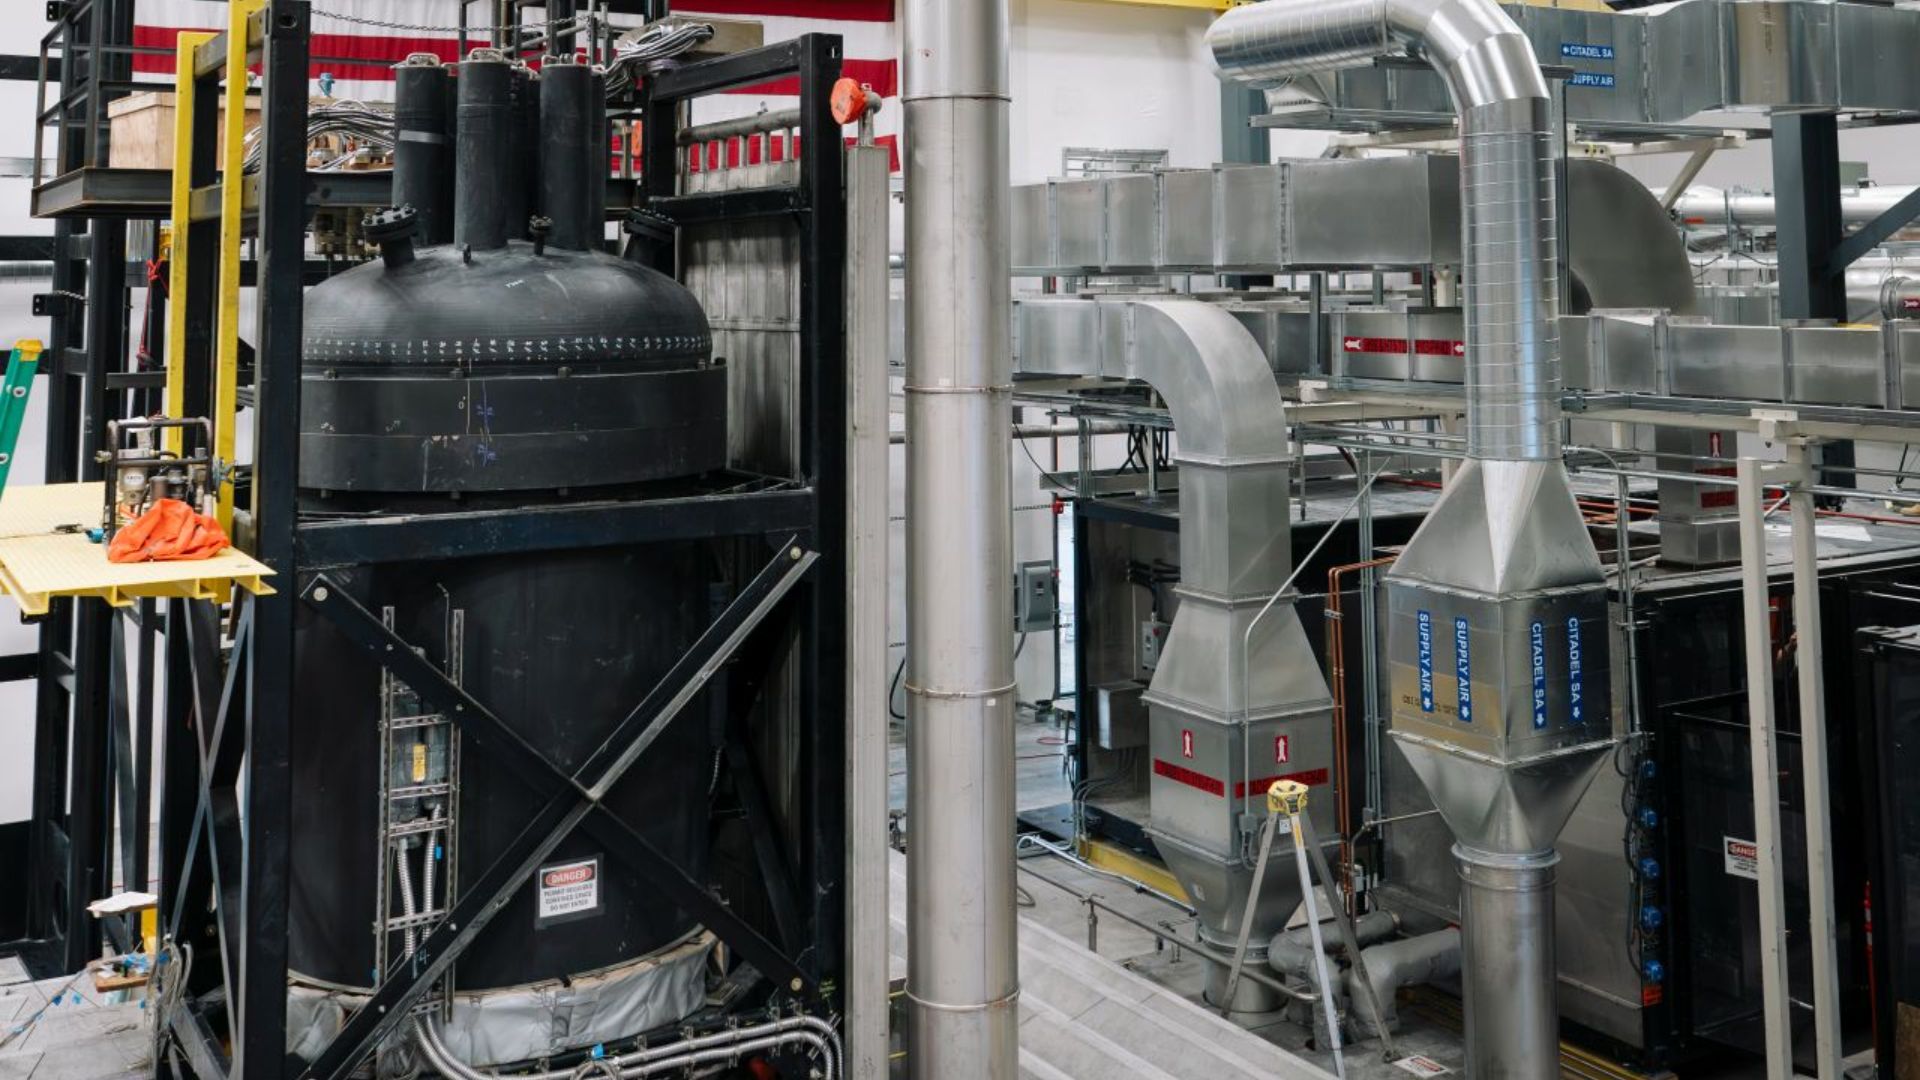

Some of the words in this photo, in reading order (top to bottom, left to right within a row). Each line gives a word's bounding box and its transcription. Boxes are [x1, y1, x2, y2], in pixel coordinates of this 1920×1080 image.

[1570, 45, 1601, 58] CITADEL
[1602, 47, 1613, 58] SA
[1601, 75, 1614, 87] AIR
[1419, 613, 1431, 668] SUPPLY
[1456, 620, 1468, 676] SUPPLY
[1568, 617, 1580, 680] CITADEL
[1532, 622, 1544, 686] CITADEL
[1421, 668, 1432, 693] AIR
[1459, 676, 1470, 703] AIR
[1571, 682, 1581, 704] SA
[1535, 688, 1545, 710] SA
[551, 869, 586, 884] DANGER
